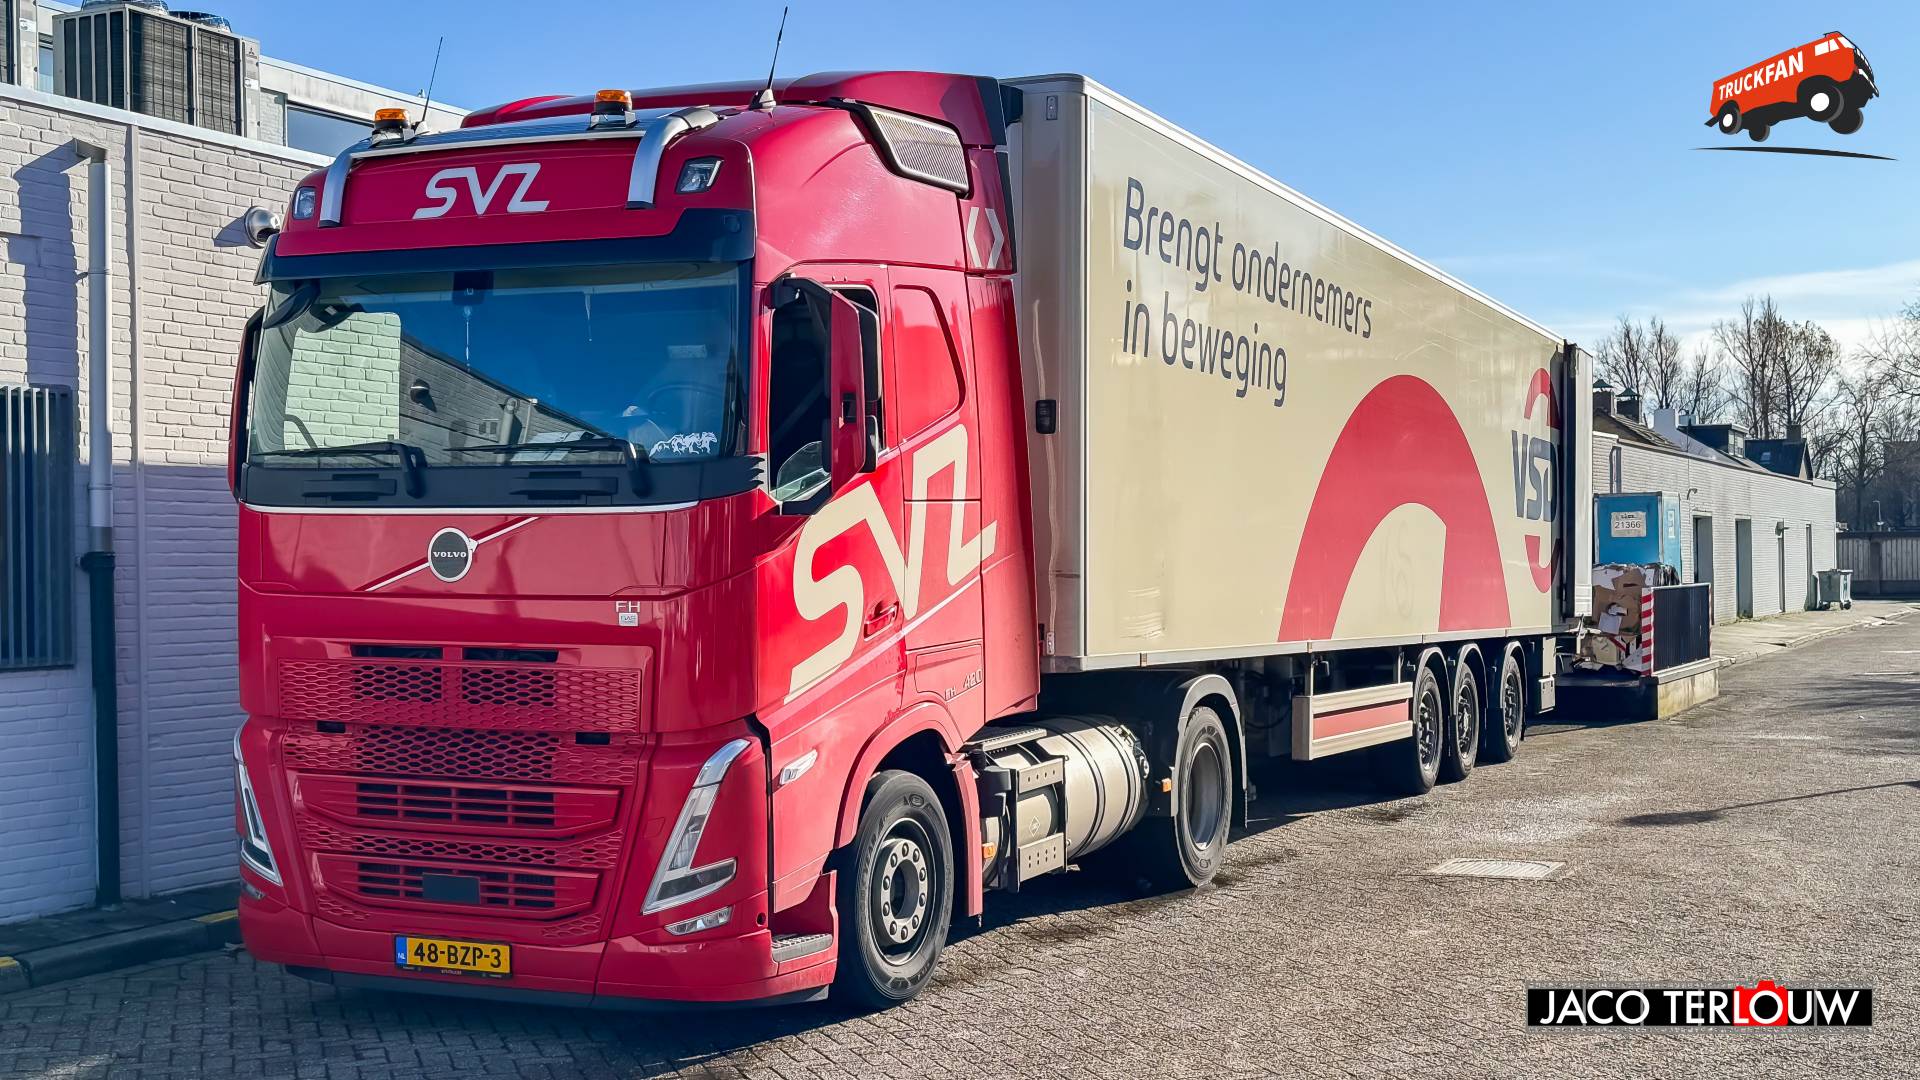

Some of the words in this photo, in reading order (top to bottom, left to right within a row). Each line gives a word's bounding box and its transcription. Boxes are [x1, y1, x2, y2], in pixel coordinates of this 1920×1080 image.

[412, 162, 550, 220] SVZ
[1124, 176, 1223, 292] Brengt
[1231, 241, 1372, 339] ondernemers
[1122, 279, 1150, 358] in
[1162, 290, 1287, 407] beweging
[1511, 429, 1562, 523] VSD
[1614, 520, 1641, 529] 21366
[784, 423, 998, 706] SVZ
[615, 600, 641, 613] FH
[413, 942, 502, 969] 48-BZP-3
